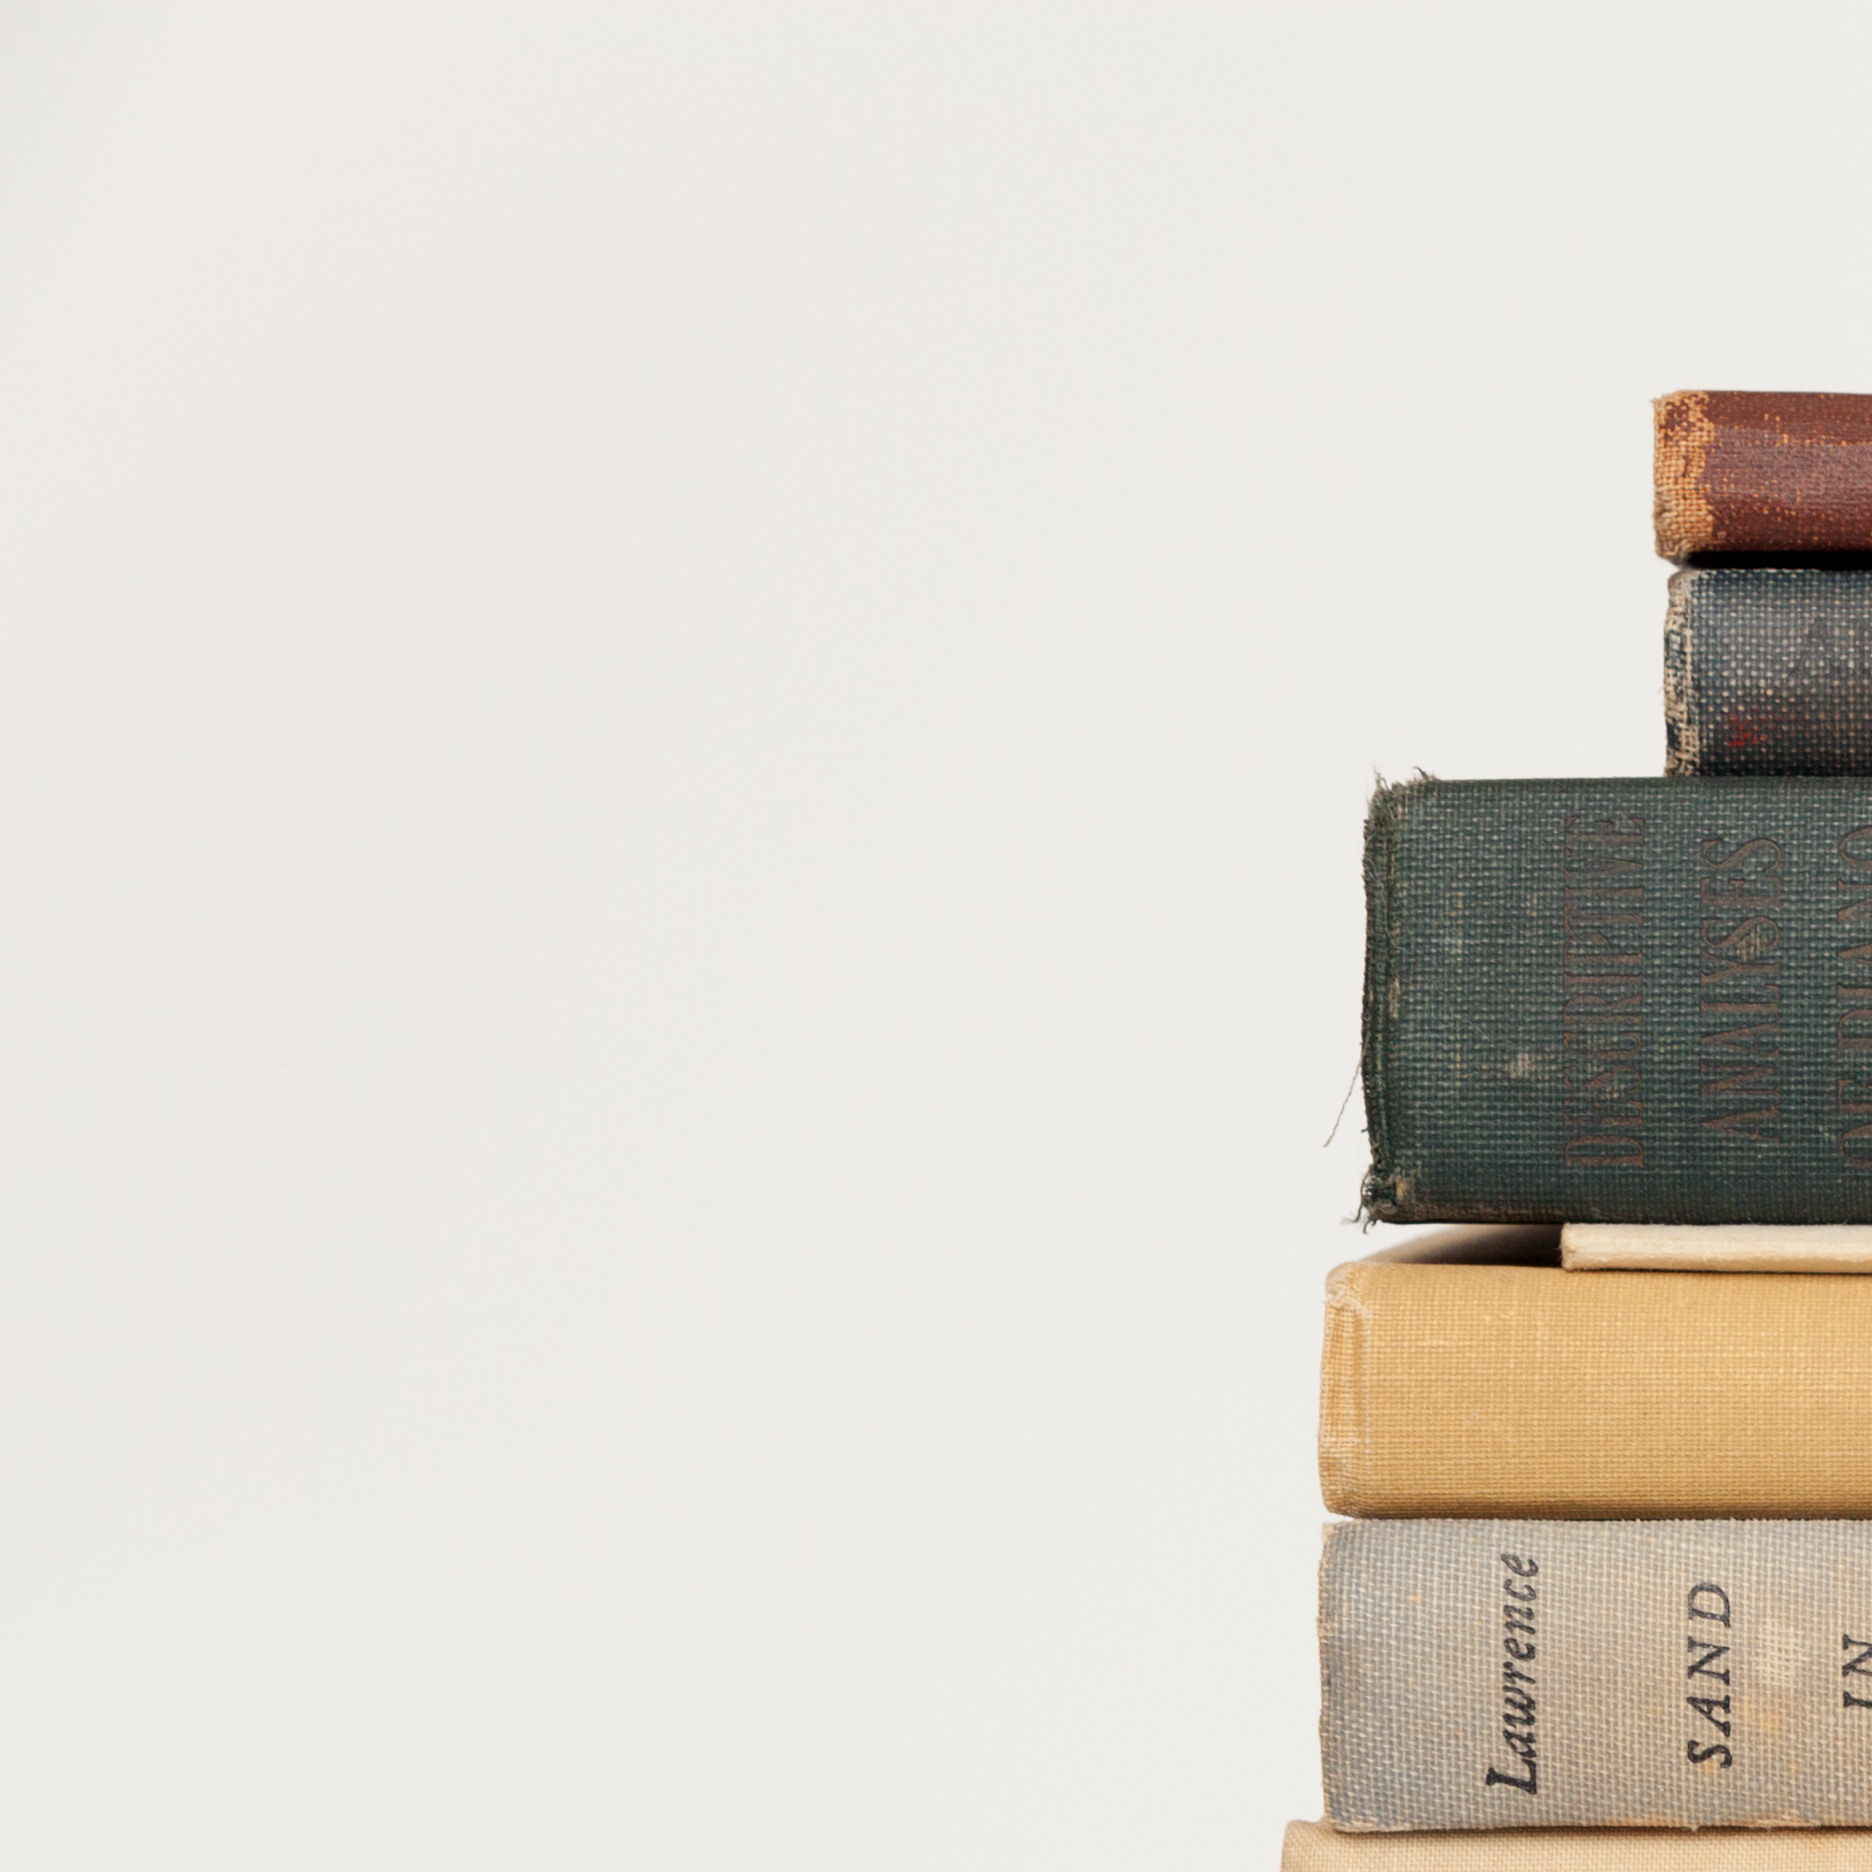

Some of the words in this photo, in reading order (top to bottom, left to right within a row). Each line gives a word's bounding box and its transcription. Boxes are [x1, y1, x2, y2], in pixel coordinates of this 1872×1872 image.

[1563, 814, 1646, 1167] DESCRIPTIVE
[1700, 836, 1783, 1145] ANALYSES
[1486, 1552, 1540, 1796] Lawrence
[1687, 1580, 1733, 1769] SAND
